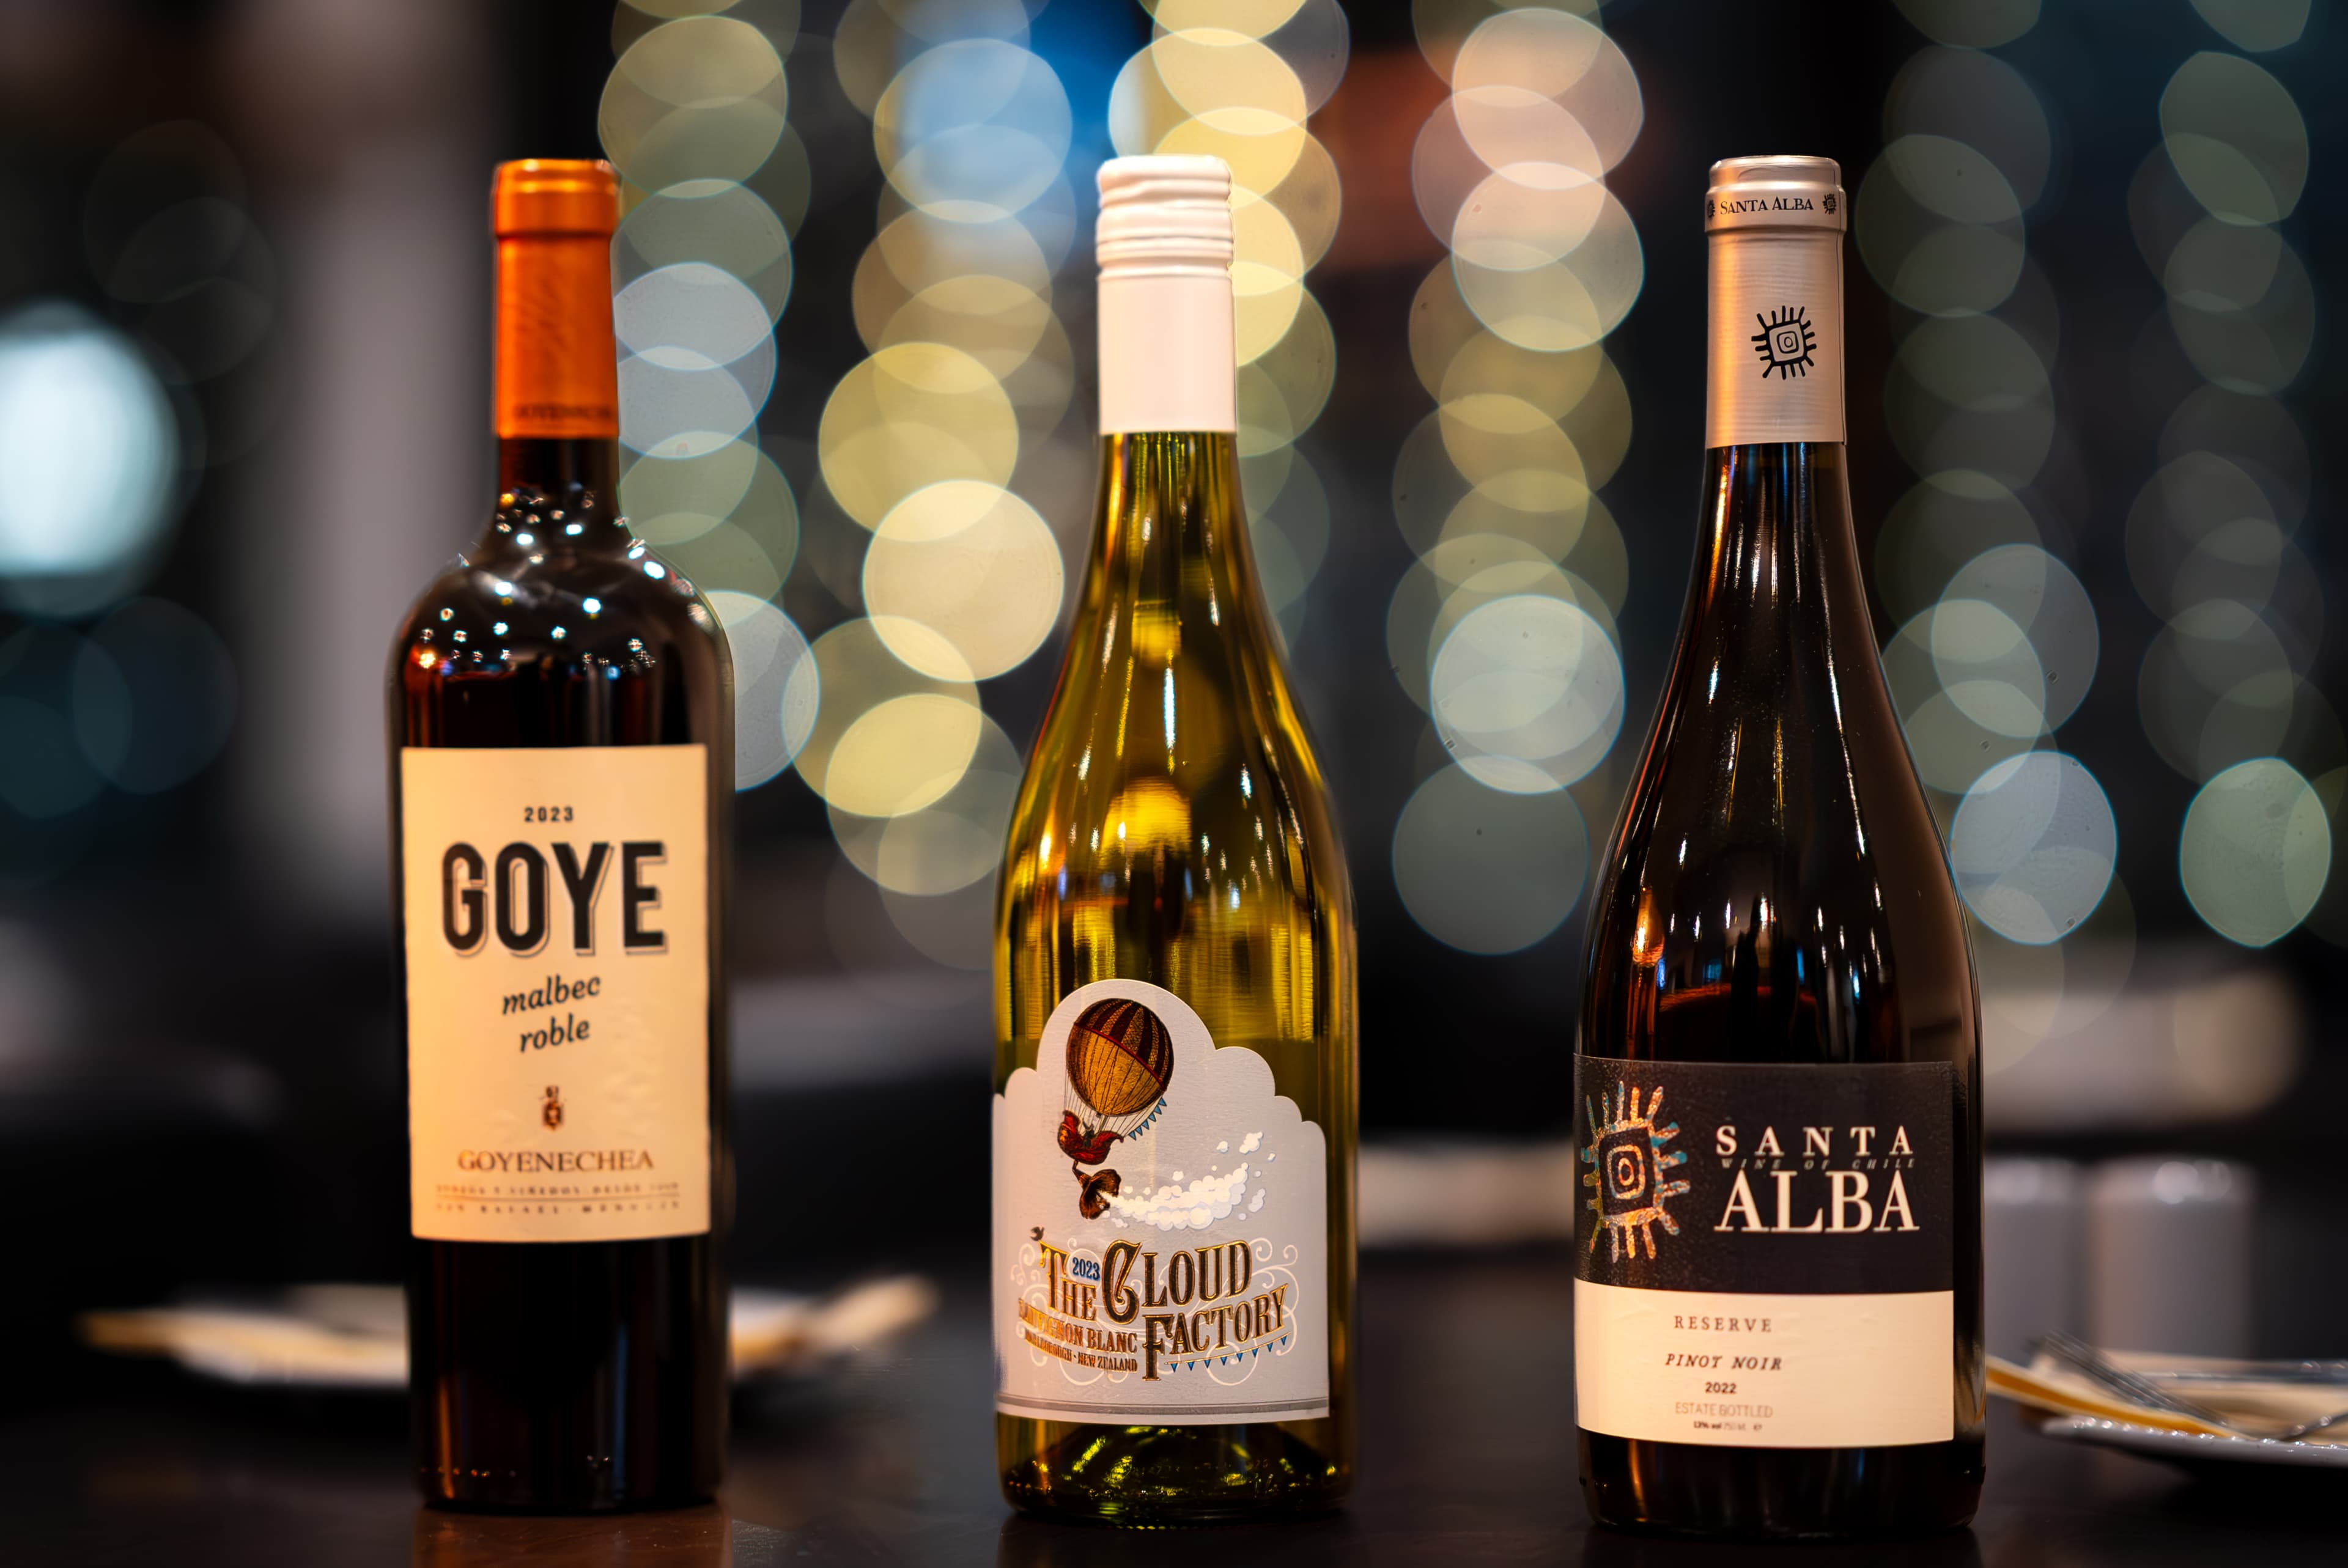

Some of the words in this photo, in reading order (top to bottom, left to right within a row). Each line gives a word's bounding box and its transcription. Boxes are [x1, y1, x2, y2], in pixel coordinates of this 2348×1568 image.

[1720, 199, 1768, 215] SANTA
[1772, 196, 1814, 210] ALBA
[524, 807, 574, 822] 2023
[441, 841, 668, 957] GOYE
[502, 973, 600, 1015] malbec
[520, 1012, 590, 1053] roble
[1716, 1125, 1913, 1156] SANTA
[457, 1150, 654, 1172] GOYENECHEA
[1721, 1158, 1781, 1169] WINE
[1714, 1169, 1920, 1234] ALBA
[1072, 1256, 1101, 1282] 2023
[1039, 1239, 1097, 1322] THE
[1101, 1239, 1252, 1325] CLOUD
[1142, 1283, 1288, 1382] FACTORY
[1674, 1315, 1772, 1333] RESERVE
[1087, 1327, 1137, 1354] BLANC
[1078, 1351, 1096, 1367] NEW
[1098, 1355, 1138, 1372] ZEALAND
[1665, 1353, 1722, 1369] PINOT
[1732, 1356, 1782, 1370] NOIR
[1705, 1382, 1737, 1394] 2022
[1675, 1402, 1716, 1417] ESTATE
